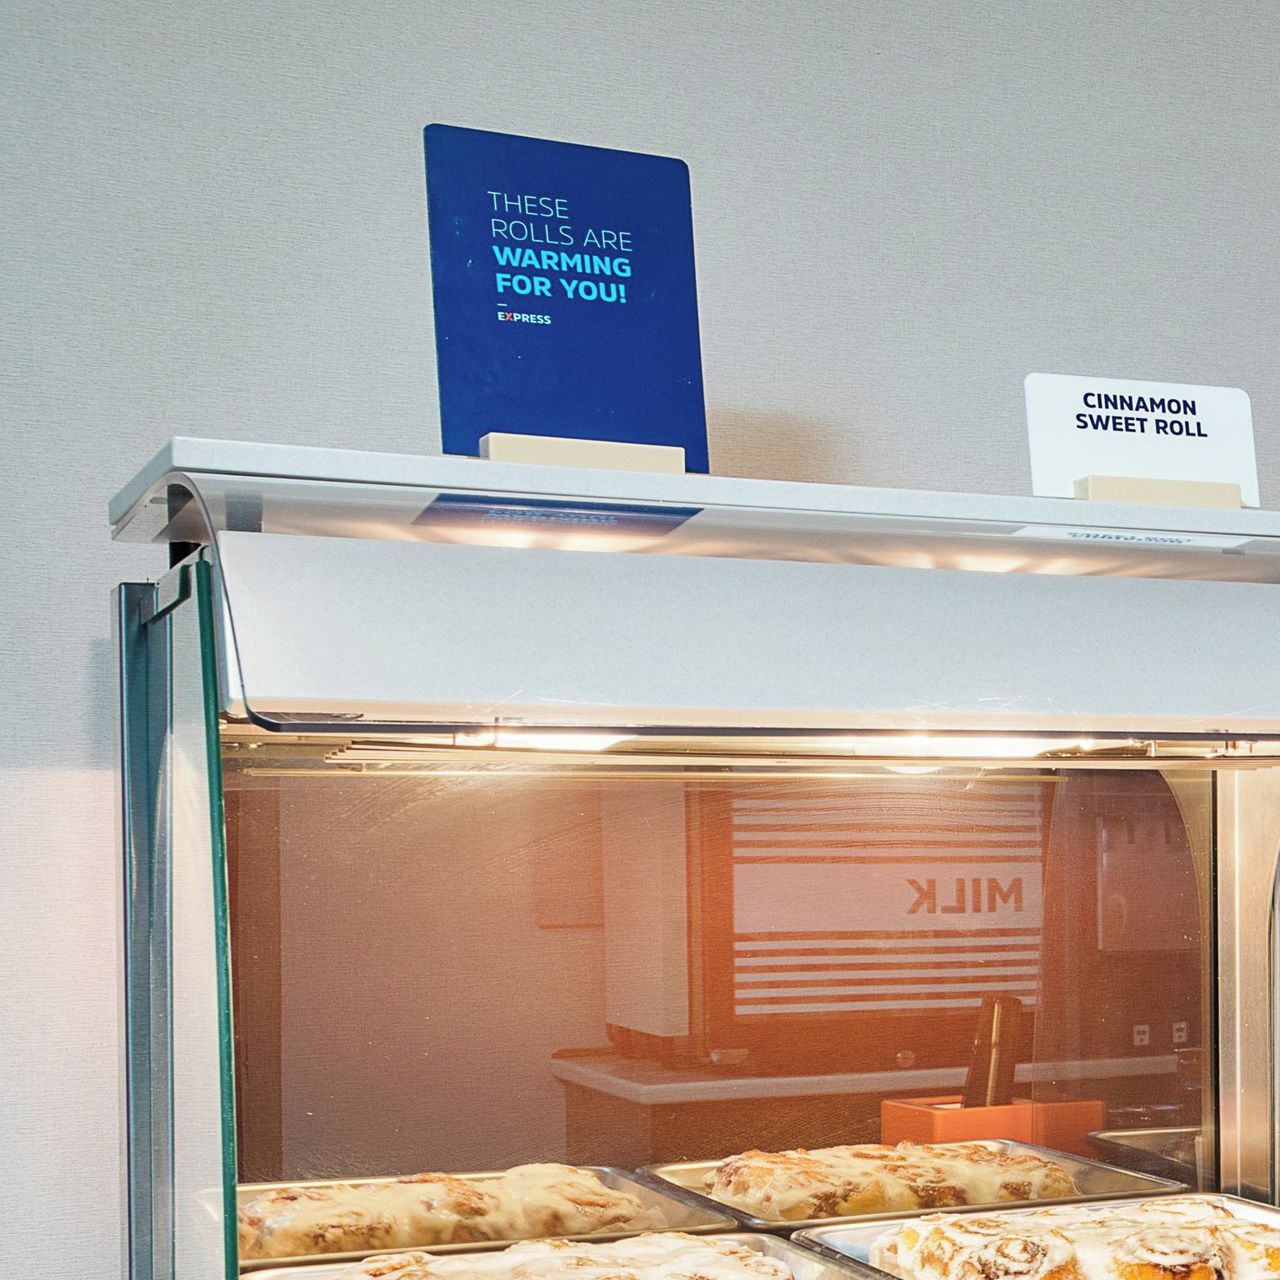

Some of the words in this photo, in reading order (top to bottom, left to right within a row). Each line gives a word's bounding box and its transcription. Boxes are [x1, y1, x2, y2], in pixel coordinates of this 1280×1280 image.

[487, 191, 569, 219] THESE
[491, 219, 574, 246] ROLLS
[583, 228, 633, 252] ARE
[492, 245, 632, 278] WARMING
[495, 273, 552, 297] FOR
[559, 279, 627, 304] YOU!
[497, 311, 551, 325] EXPRESS
[1082, 392, 1197, 416] CINNAMON
[1075, 413, 1148, 434] SWEET
[1155, 419, 1208, 438] ROLL
